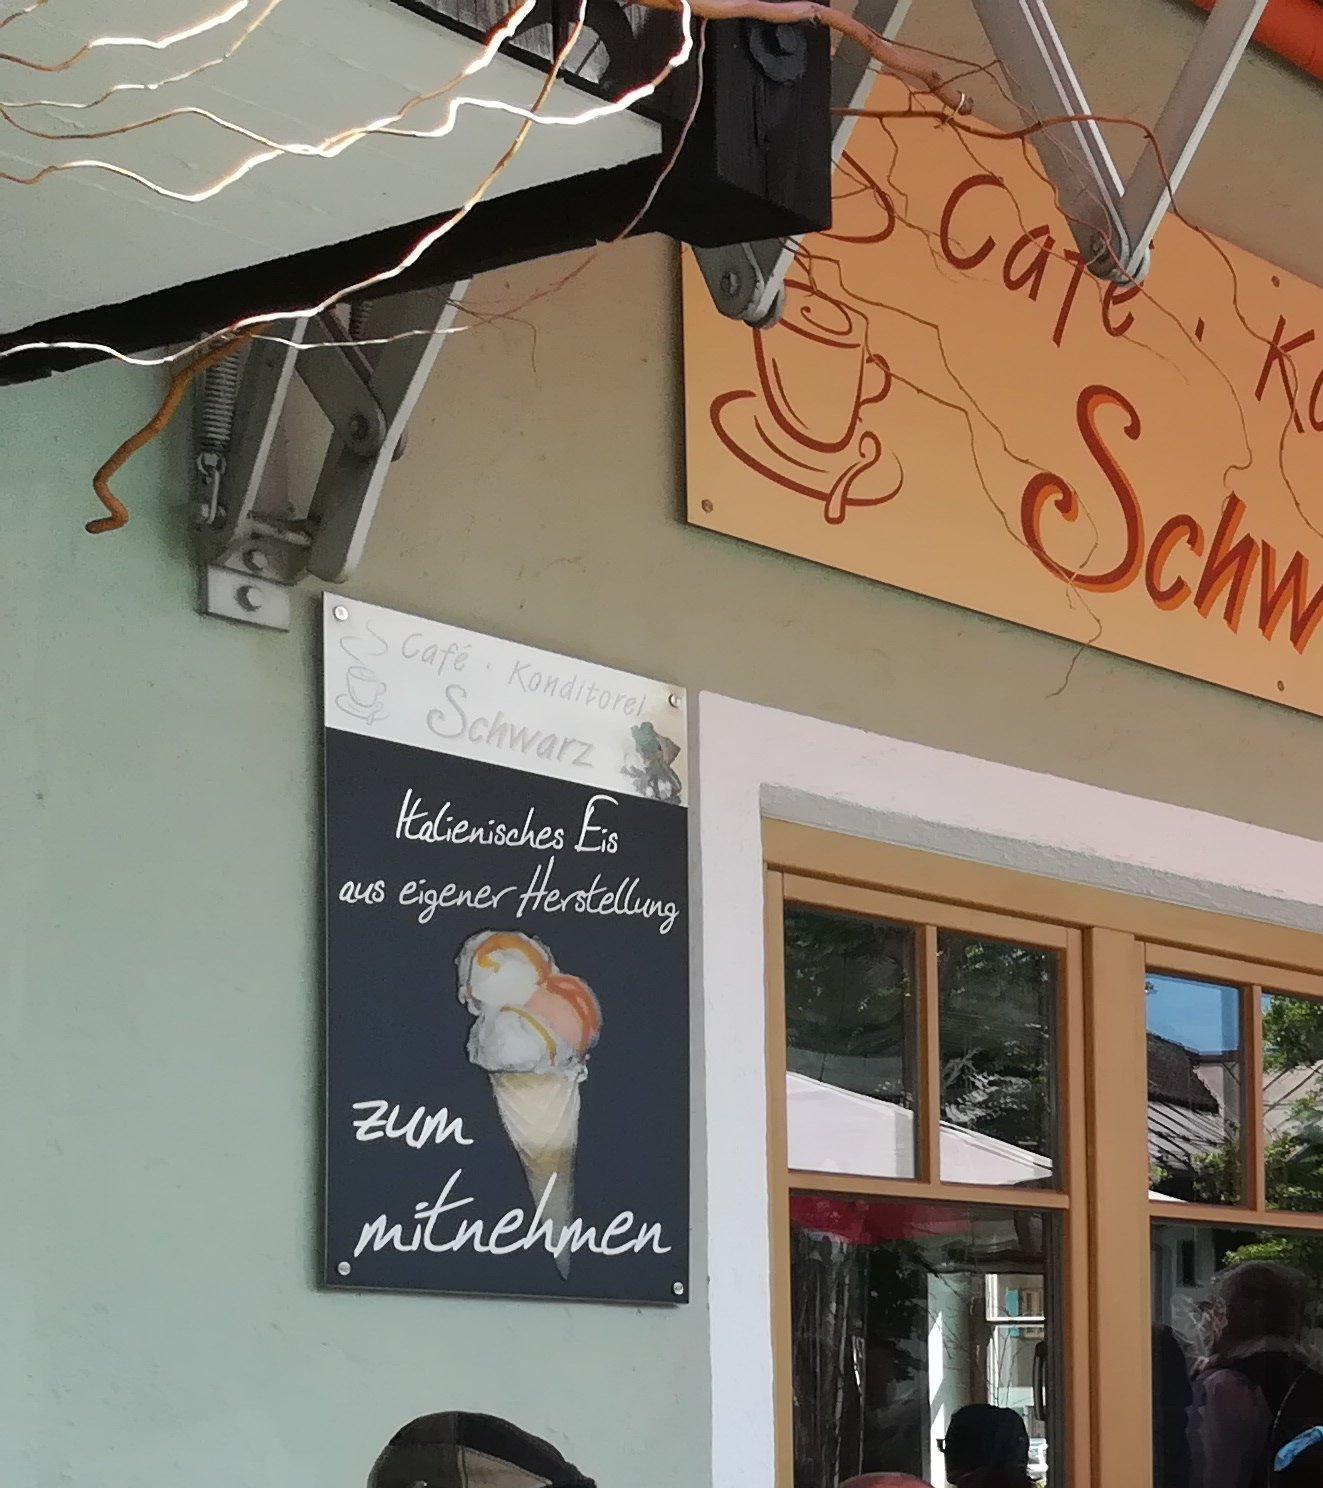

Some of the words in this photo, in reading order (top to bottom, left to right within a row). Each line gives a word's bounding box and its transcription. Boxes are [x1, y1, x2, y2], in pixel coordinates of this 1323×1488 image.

[400, 632, 473, 676] Café
[508, 660, 648, 718] Konditorei
[426, 683, 594, 769] Schwarz
[395, 788, 565, 851] Italienisches
[574, 794, 619, 854] Eis
[338, 879, 386, 905] aus
[398, 878, 518, 925] eigener
[515, 854, 680, 935] Herstellung
[352, 1099, 475, 1150] zum
[353, 1168, 673, 1259] mitnehmen
